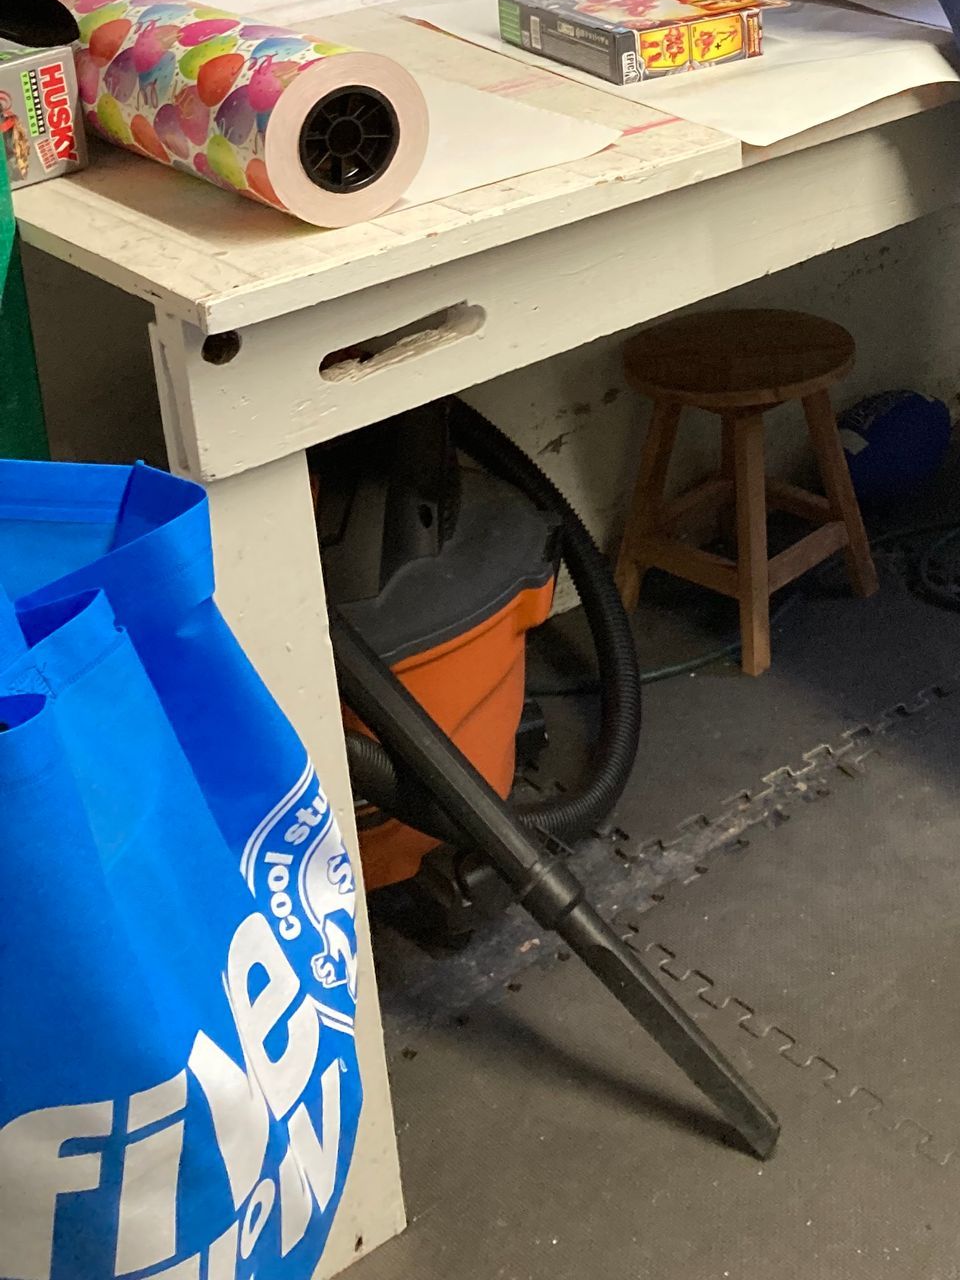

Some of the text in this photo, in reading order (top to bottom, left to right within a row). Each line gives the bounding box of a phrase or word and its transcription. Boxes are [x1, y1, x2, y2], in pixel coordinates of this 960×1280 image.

[39, 62, 78, 161] HUSKY
[264, 787, 328, 941] cool stu
[0, 913, 320, 1280] five
